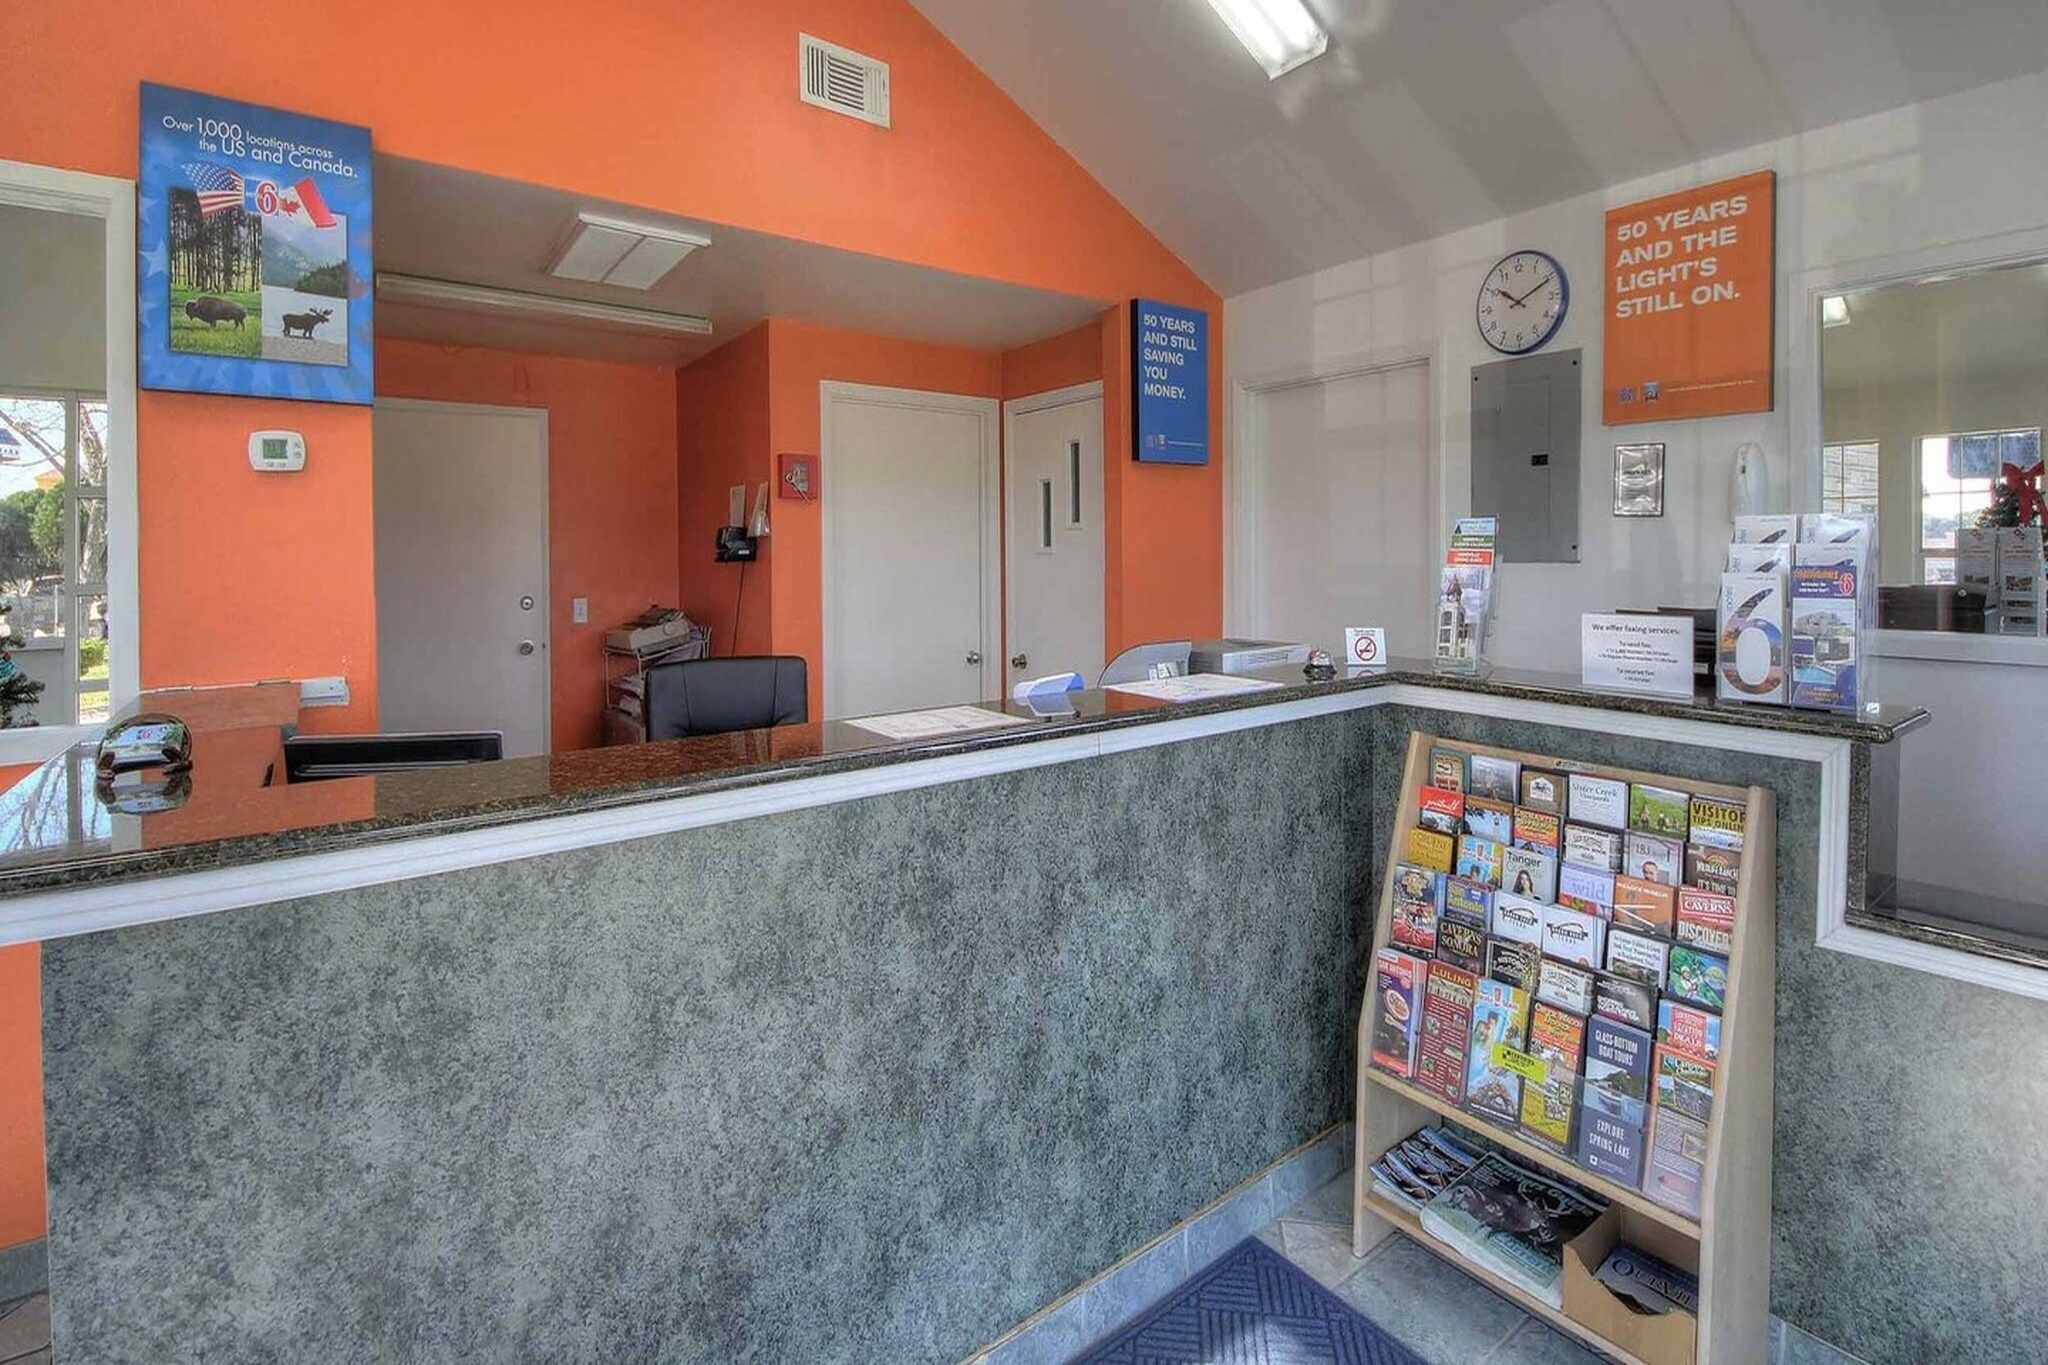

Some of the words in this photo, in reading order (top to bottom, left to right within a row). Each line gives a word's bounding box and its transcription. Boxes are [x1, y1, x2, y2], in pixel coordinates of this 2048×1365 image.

[163, 115, 193, 132] Over
[197, 117, 242, 141] 1,000
[246, 131, 295, 151] locations
[298, 143, 333, 158] across
[199, 138, 217, 153] the
[222, 139, 246, 157] US
[251, 146, 283, 164] and
[288, 152, 358, 179] Canada.
[1617, 221, 1647, 241] 50
[1654, 195, 1748, 232] YEARS
[1615, 240, 1673, 268] AND
[1681, 226, 1738, 253] THE
[1616, 257, 1718, 293] LIGHT'S
[1615, 291, 1683, 319] STILL
[1691, 281, 1740, 306] ON.
[1144, 313, 1157, 326] 50
[1160, 315, 1195, 334] YEARS
[1144, 331, 1168, 346] AND
[1170, 335, 1197, 351] STILL
[1144, 348, 1184, 366] SAVING
[1144, 365, 1168, 380] YOU
[1144, 382, 1187, 400] MONEY.
[1592, 623, 1604, 631] We
[1625, 625, 1647, 634] faxing
[1693, 815, 1711, 825] TIPS
[1715, 820, 1745, 832] ONLIN
[1507, 850, 1541, 867] Tanger
[1571, 881, 1606, 900] wild
[1684, 901, 1734, 914] CAVERNS
[1432, 964, 1472, 987] LULING
[1596, 1119, 1625, 1141] EXPLORE
[1589, 1132, 1614, 1153] SPRING
[1614, 1143, 1631, 1160] LAKE
